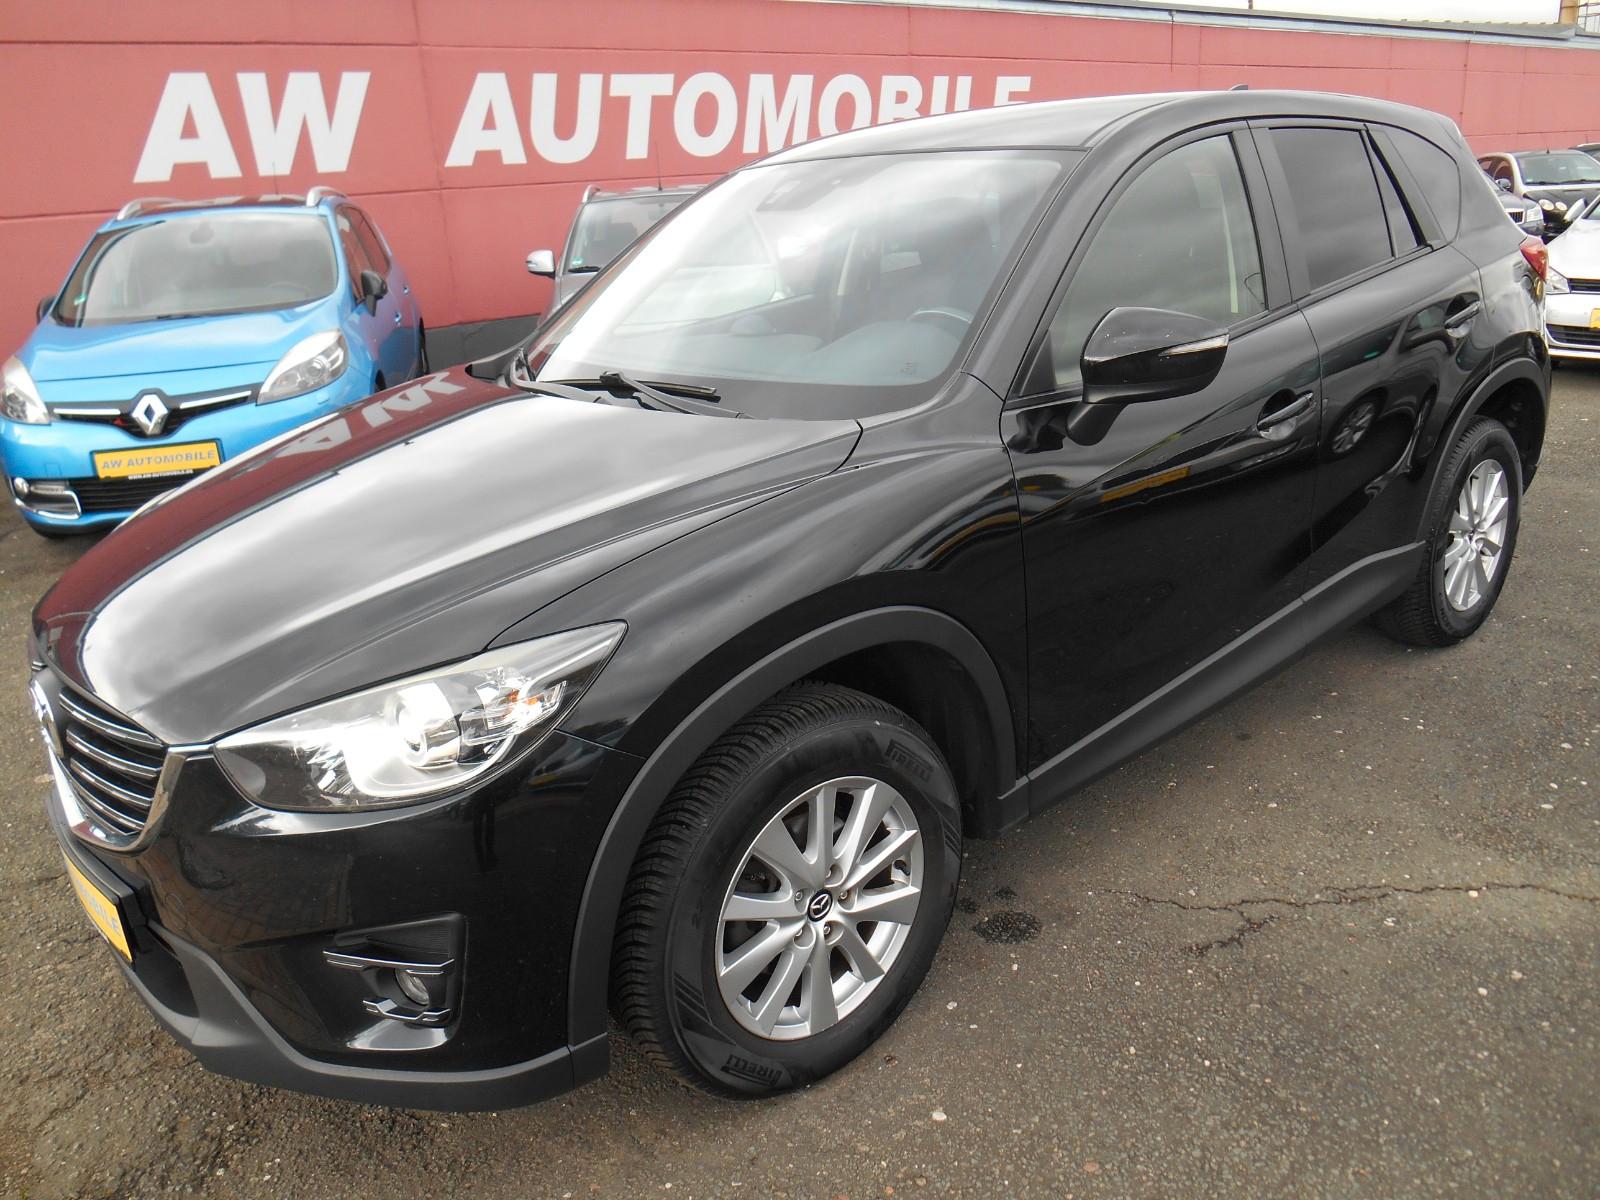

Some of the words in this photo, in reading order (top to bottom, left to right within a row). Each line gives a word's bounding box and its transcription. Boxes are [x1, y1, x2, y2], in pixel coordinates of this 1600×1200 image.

[133, 71, 371, 184] AW
[102, 459, 122, 470] AW
[127, 450, 215, 467] AUTOMOBILE
[721, 1054, 783, 1088] PIRELLI
